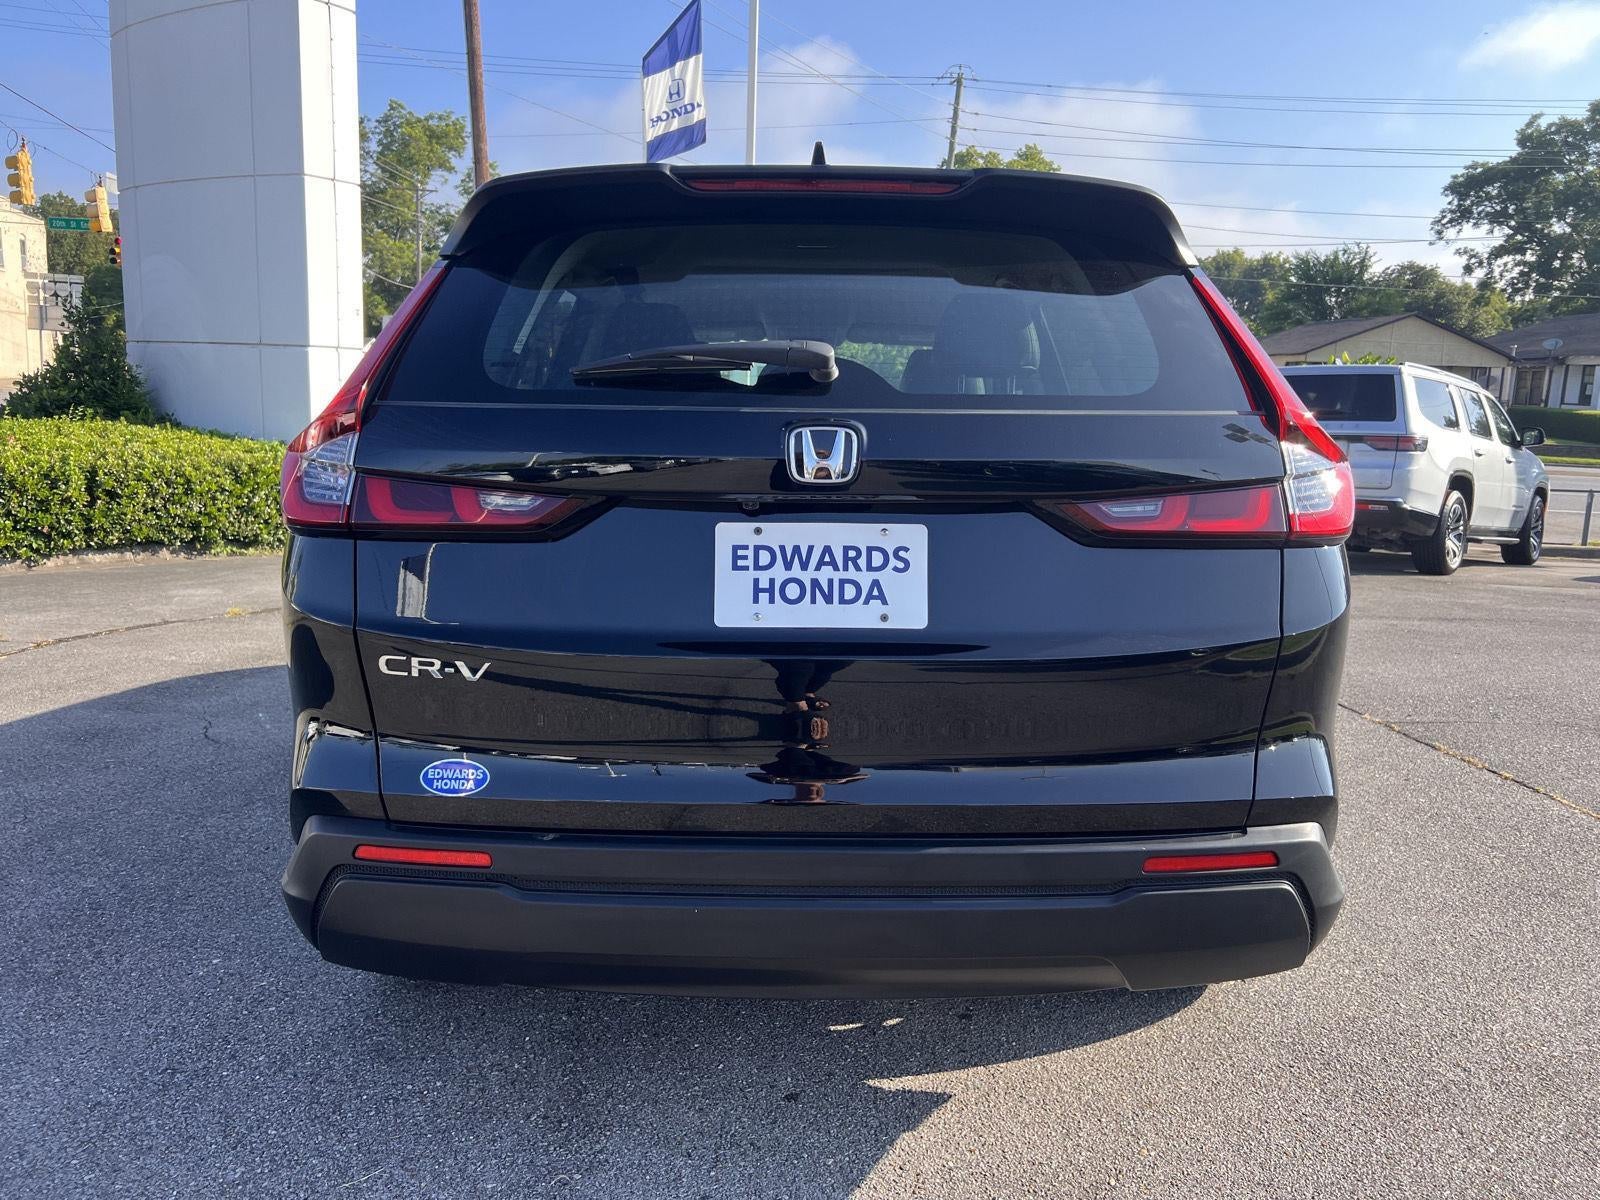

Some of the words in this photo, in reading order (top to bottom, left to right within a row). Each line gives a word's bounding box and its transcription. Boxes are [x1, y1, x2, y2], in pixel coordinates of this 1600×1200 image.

[731, 544, 911, 574] EDWARDS
[752, 577, 889, 606] HONDA
[378, 655, 492, 682] CR-V
[428, 769, 484, 779] EDWARDS
[433, 779, 476, 790] HONDA
